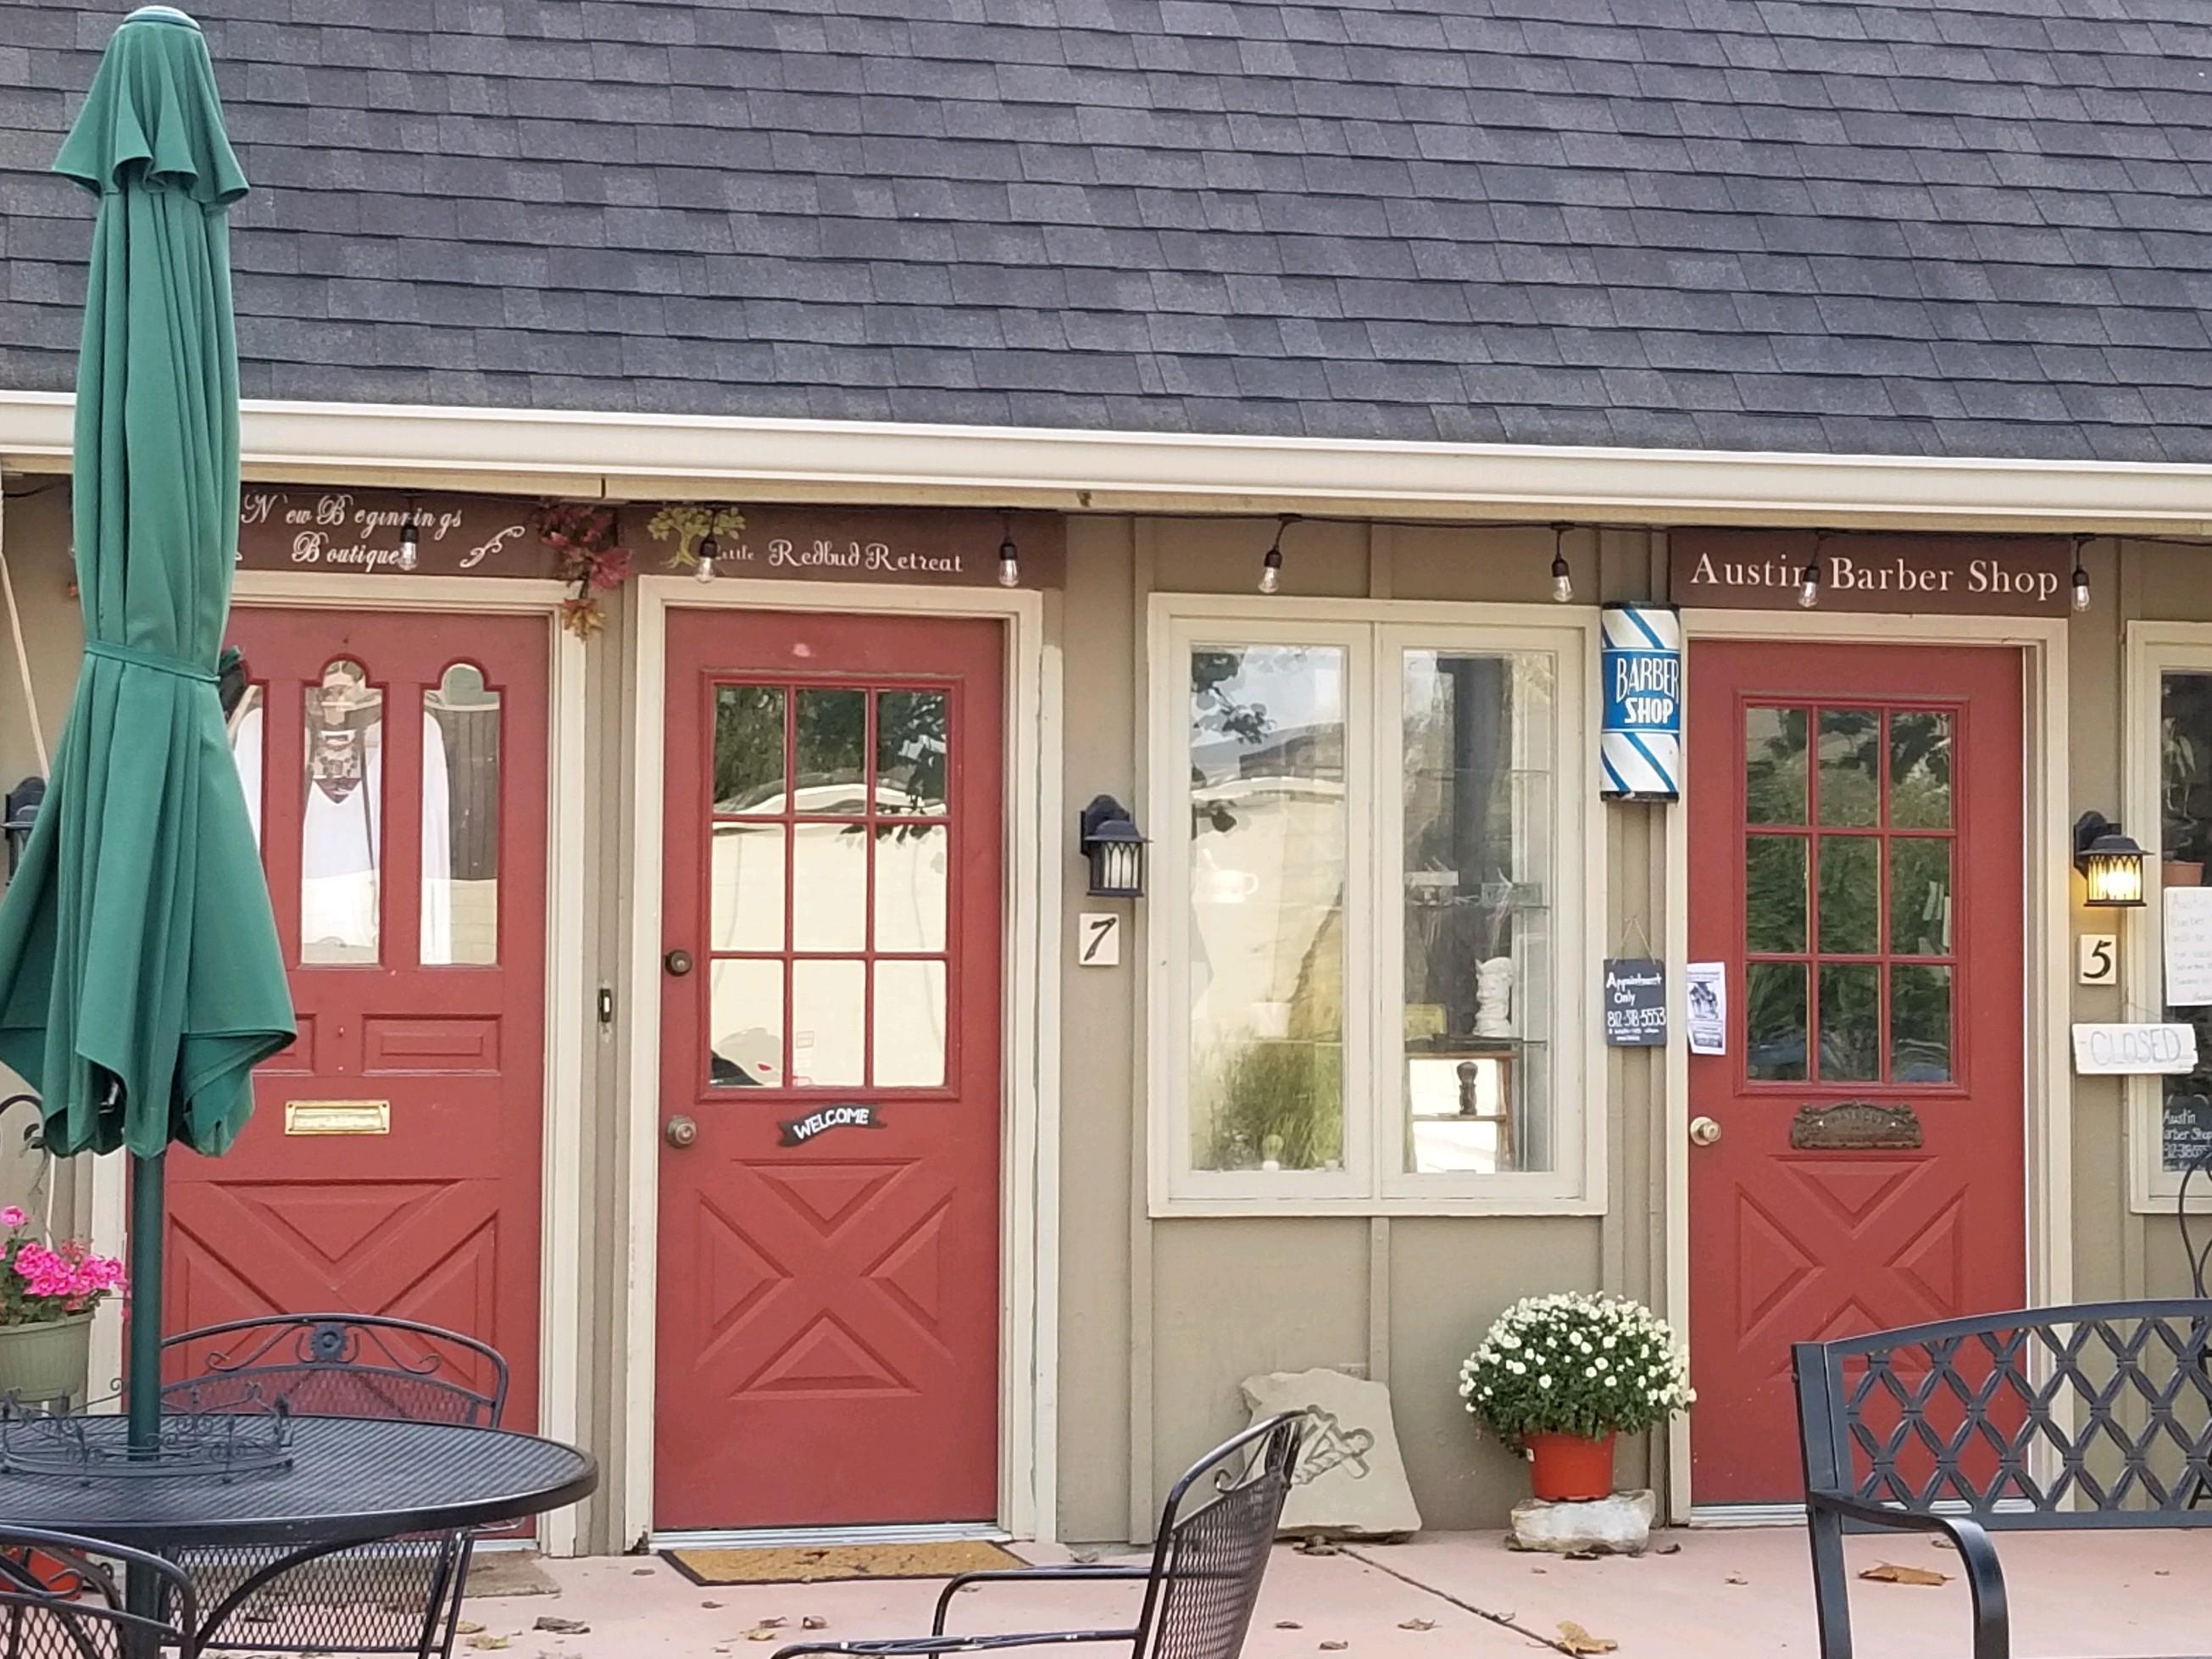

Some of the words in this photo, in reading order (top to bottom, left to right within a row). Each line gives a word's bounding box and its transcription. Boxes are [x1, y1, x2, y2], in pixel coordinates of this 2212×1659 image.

[241, 494, 313, 524] New
[291, 530, 400, 573] Boutique
[768, 538, 860, 567] Redbud
[864, 543, 964, 573] Retreat
[1829, 557, 1954, 592] Barber
[1968, 559, 2059, 601] Shop
[1615, 657, 1680, 704] BARBER
[1624, 697, 1674, 724] SHOP
[1083, 916, 1117, 961] 7
[2082, 938, 2112, 979] 5
[1614, 989, 1636, 1006] Only
[2090, 1027, 2181, 1066] CLOSED
[792, 1107, 870, 1140] WELCOME
